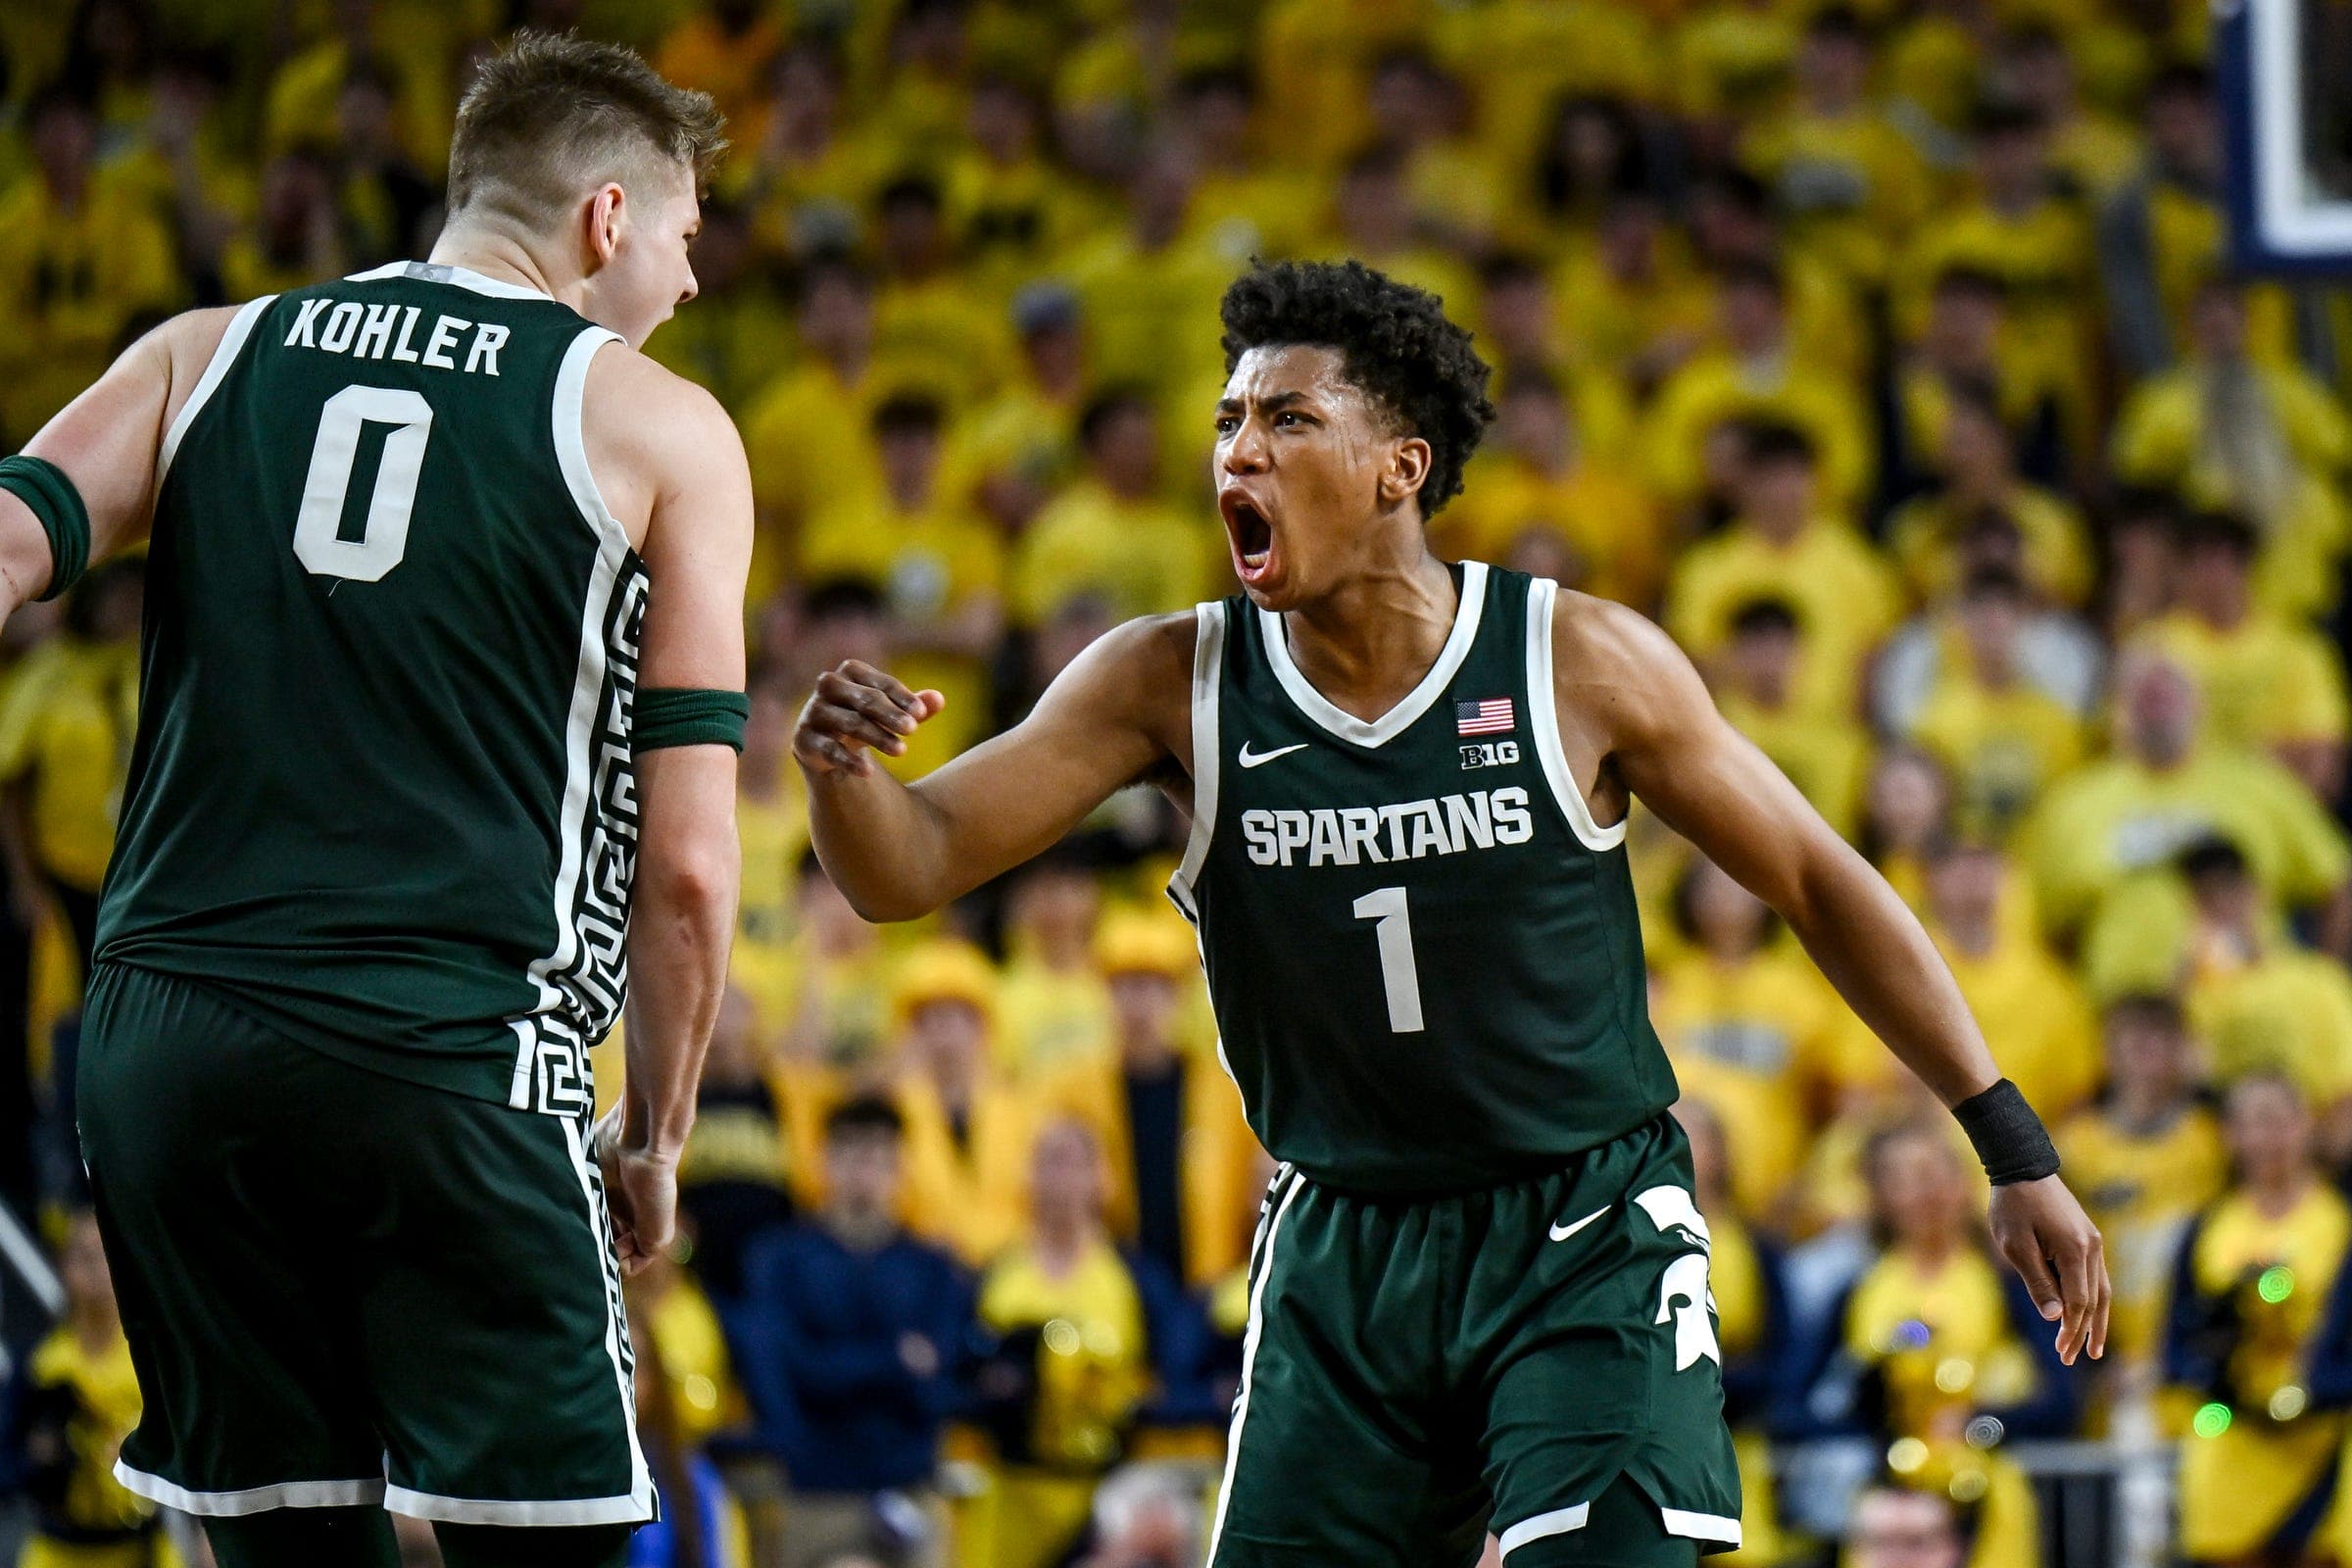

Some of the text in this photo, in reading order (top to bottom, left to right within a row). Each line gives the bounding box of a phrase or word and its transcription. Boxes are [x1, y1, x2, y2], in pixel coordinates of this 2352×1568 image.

[284, 298, 511, 376] KOHLER
[293, 384, 433, 582] 0
[1242, 787, 1533, 866] SPARTANS
[1352, 886, 1425, 1033] 1
